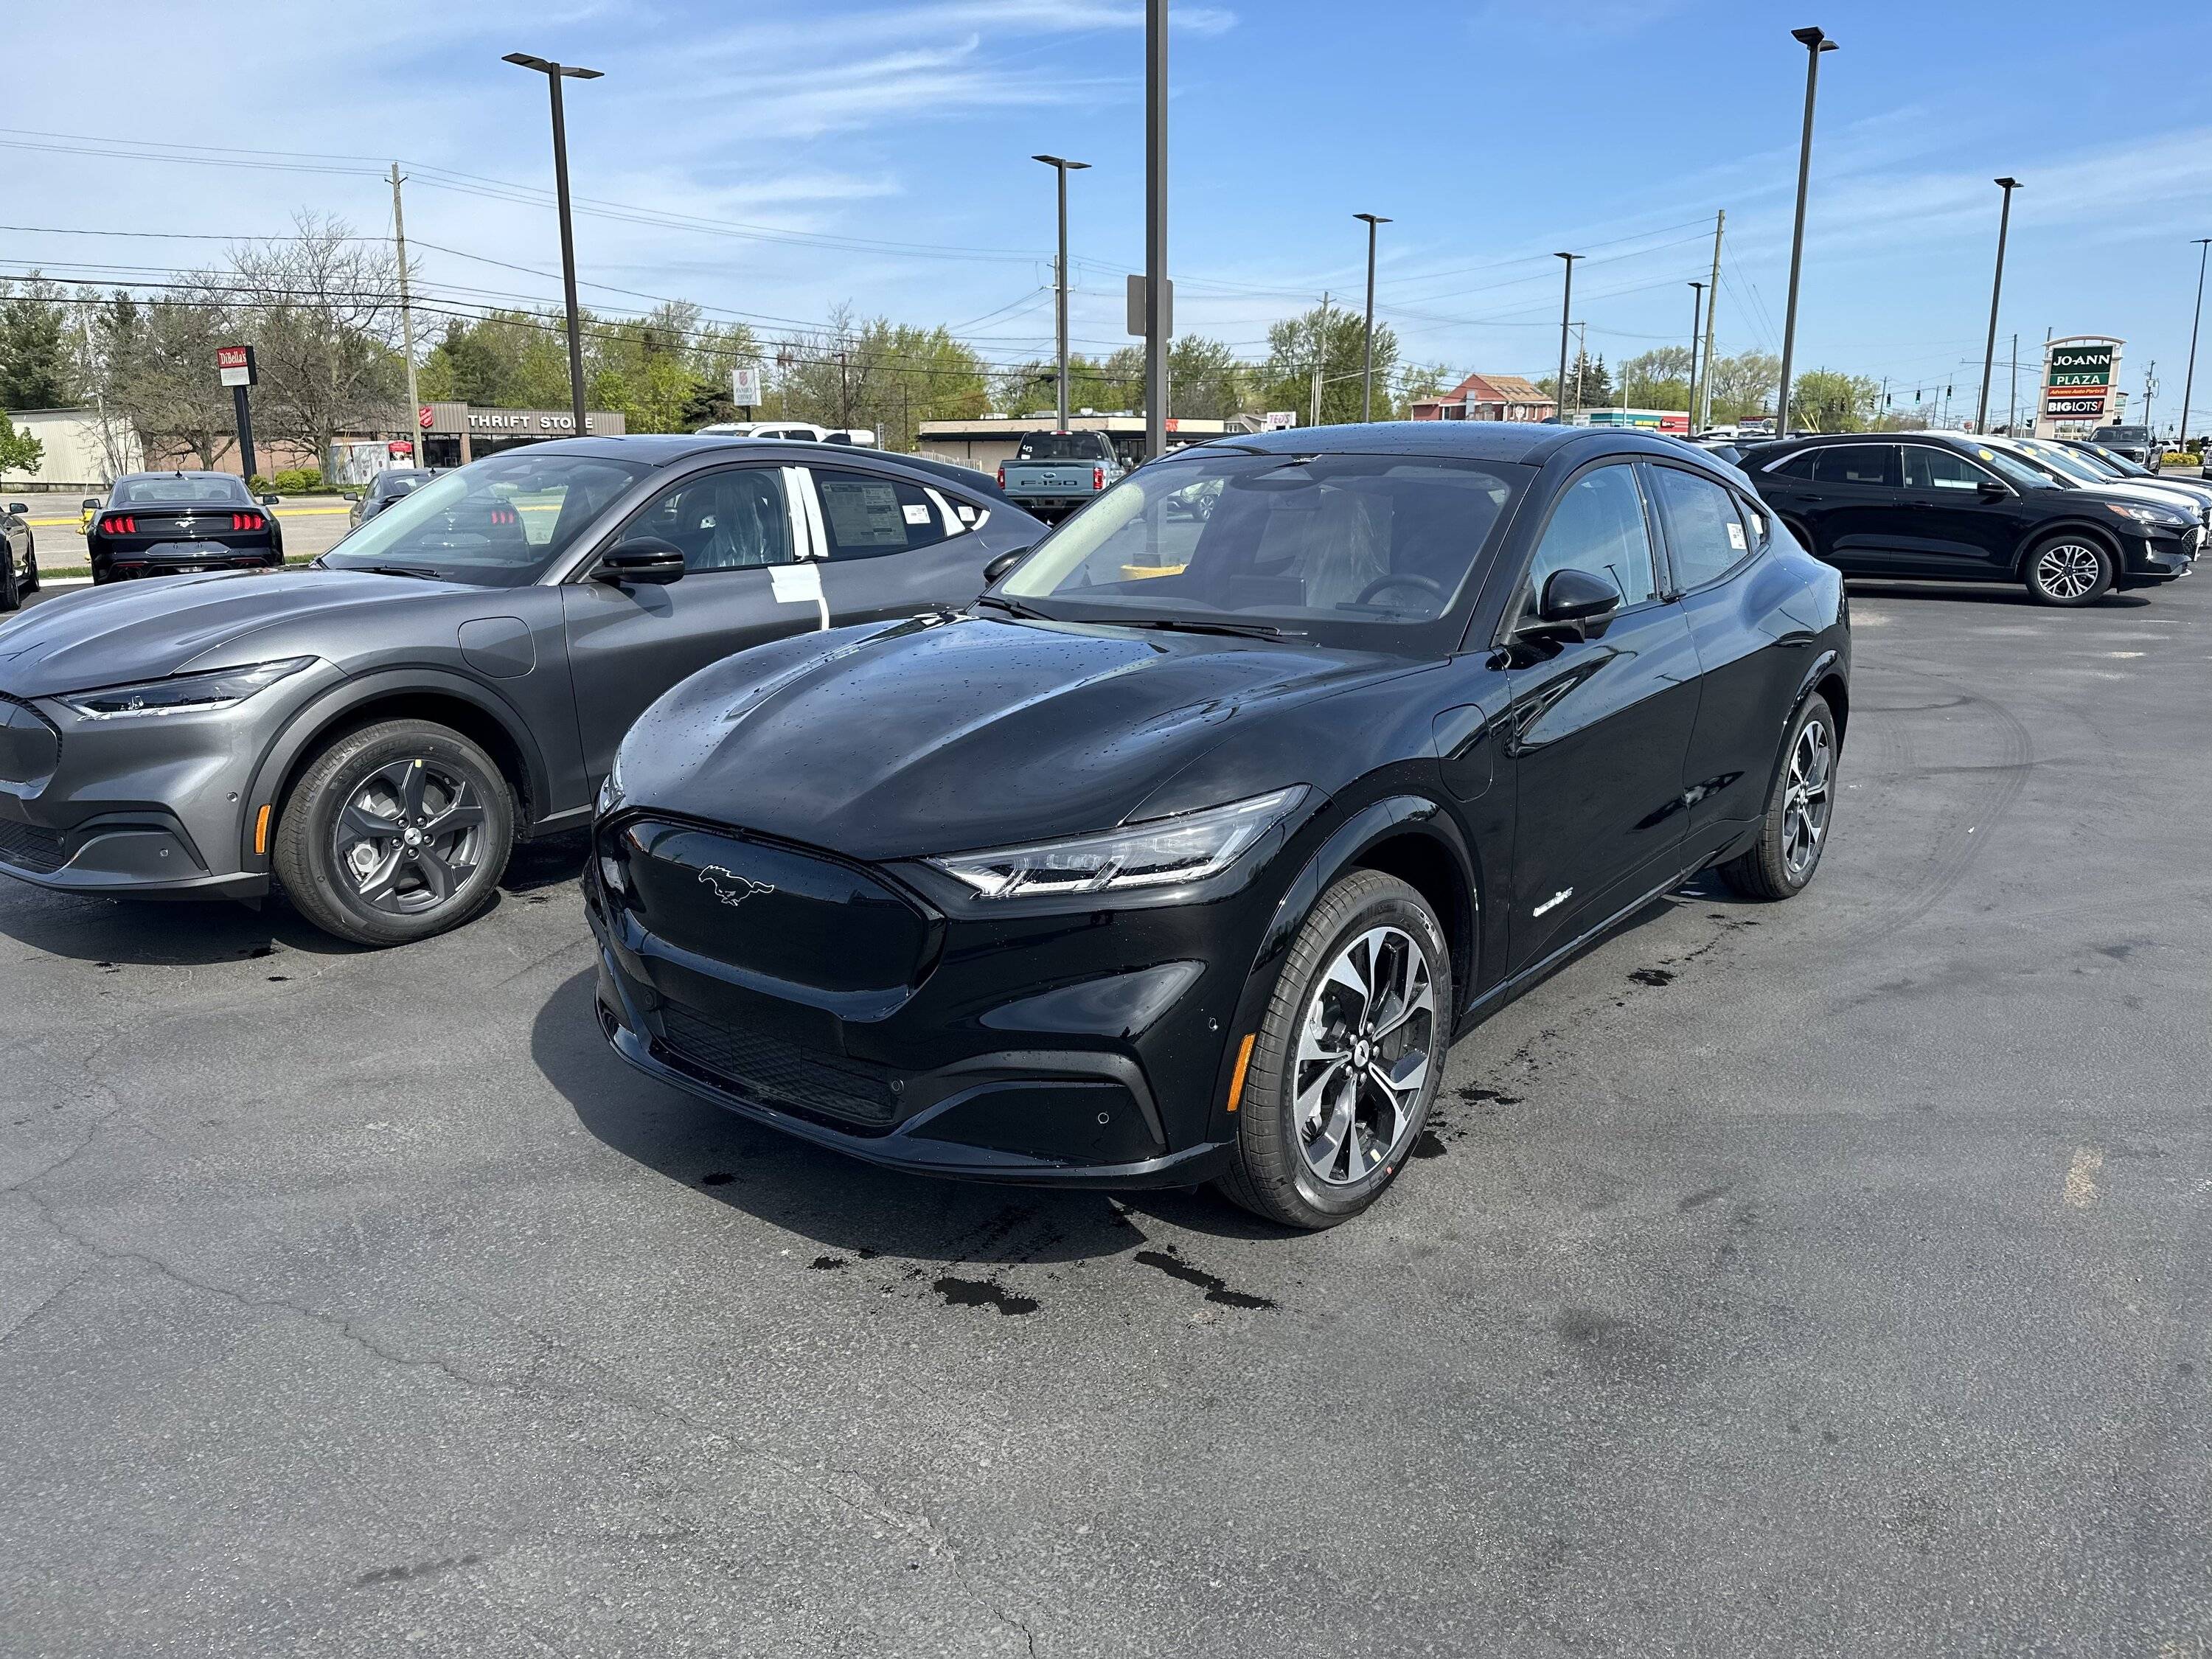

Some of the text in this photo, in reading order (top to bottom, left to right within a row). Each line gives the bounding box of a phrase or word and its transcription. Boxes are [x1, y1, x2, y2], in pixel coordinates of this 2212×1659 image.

[218, 351, 246, 364] DiBella's
[2056, 375, 2101, 385] PLAZA
[468, 414, 594, 430] THRIFT STOE
[1023, 445, 1033, 453] 43
